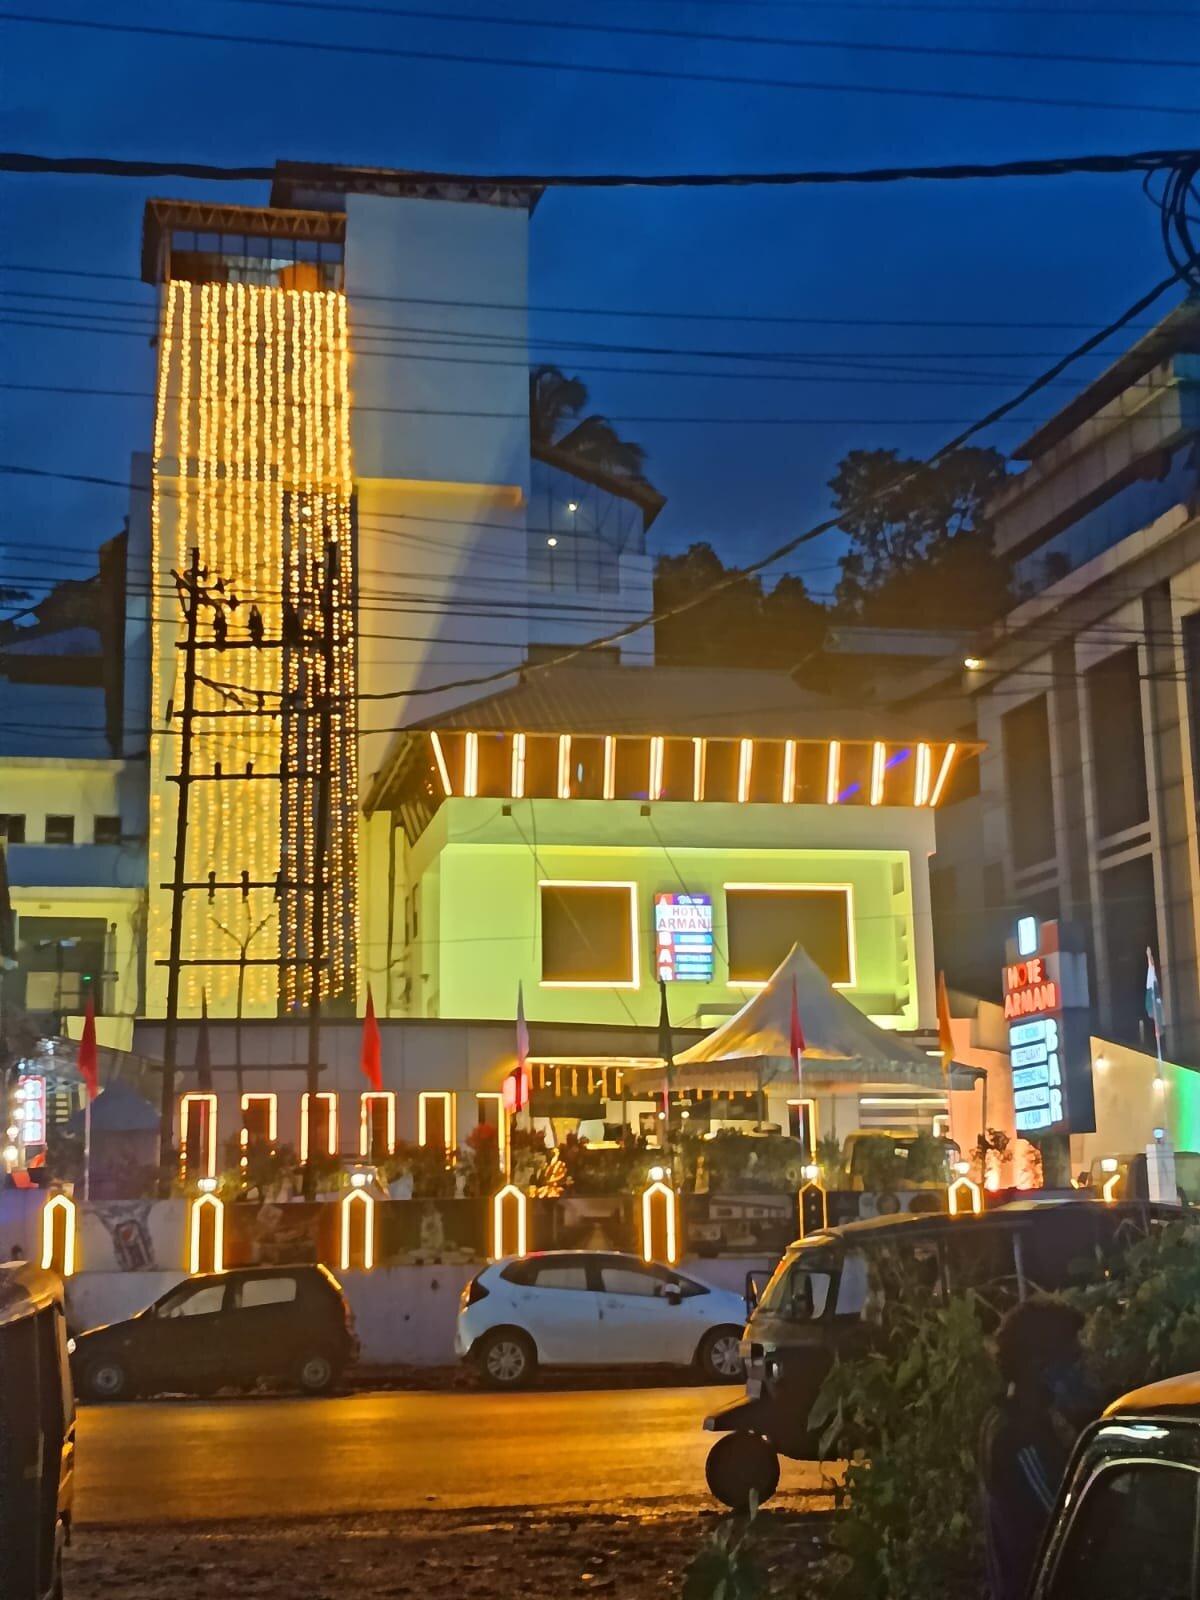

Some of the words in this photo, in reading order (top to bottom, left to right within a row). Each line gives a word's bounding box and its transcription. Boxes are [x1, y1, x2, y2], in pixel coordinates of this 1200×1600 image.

[672, 907, 710, 917] HOTEL
[658, 918, 711, 930] ARMANI
[1004, 982, 1056, 1018] ARMANI
